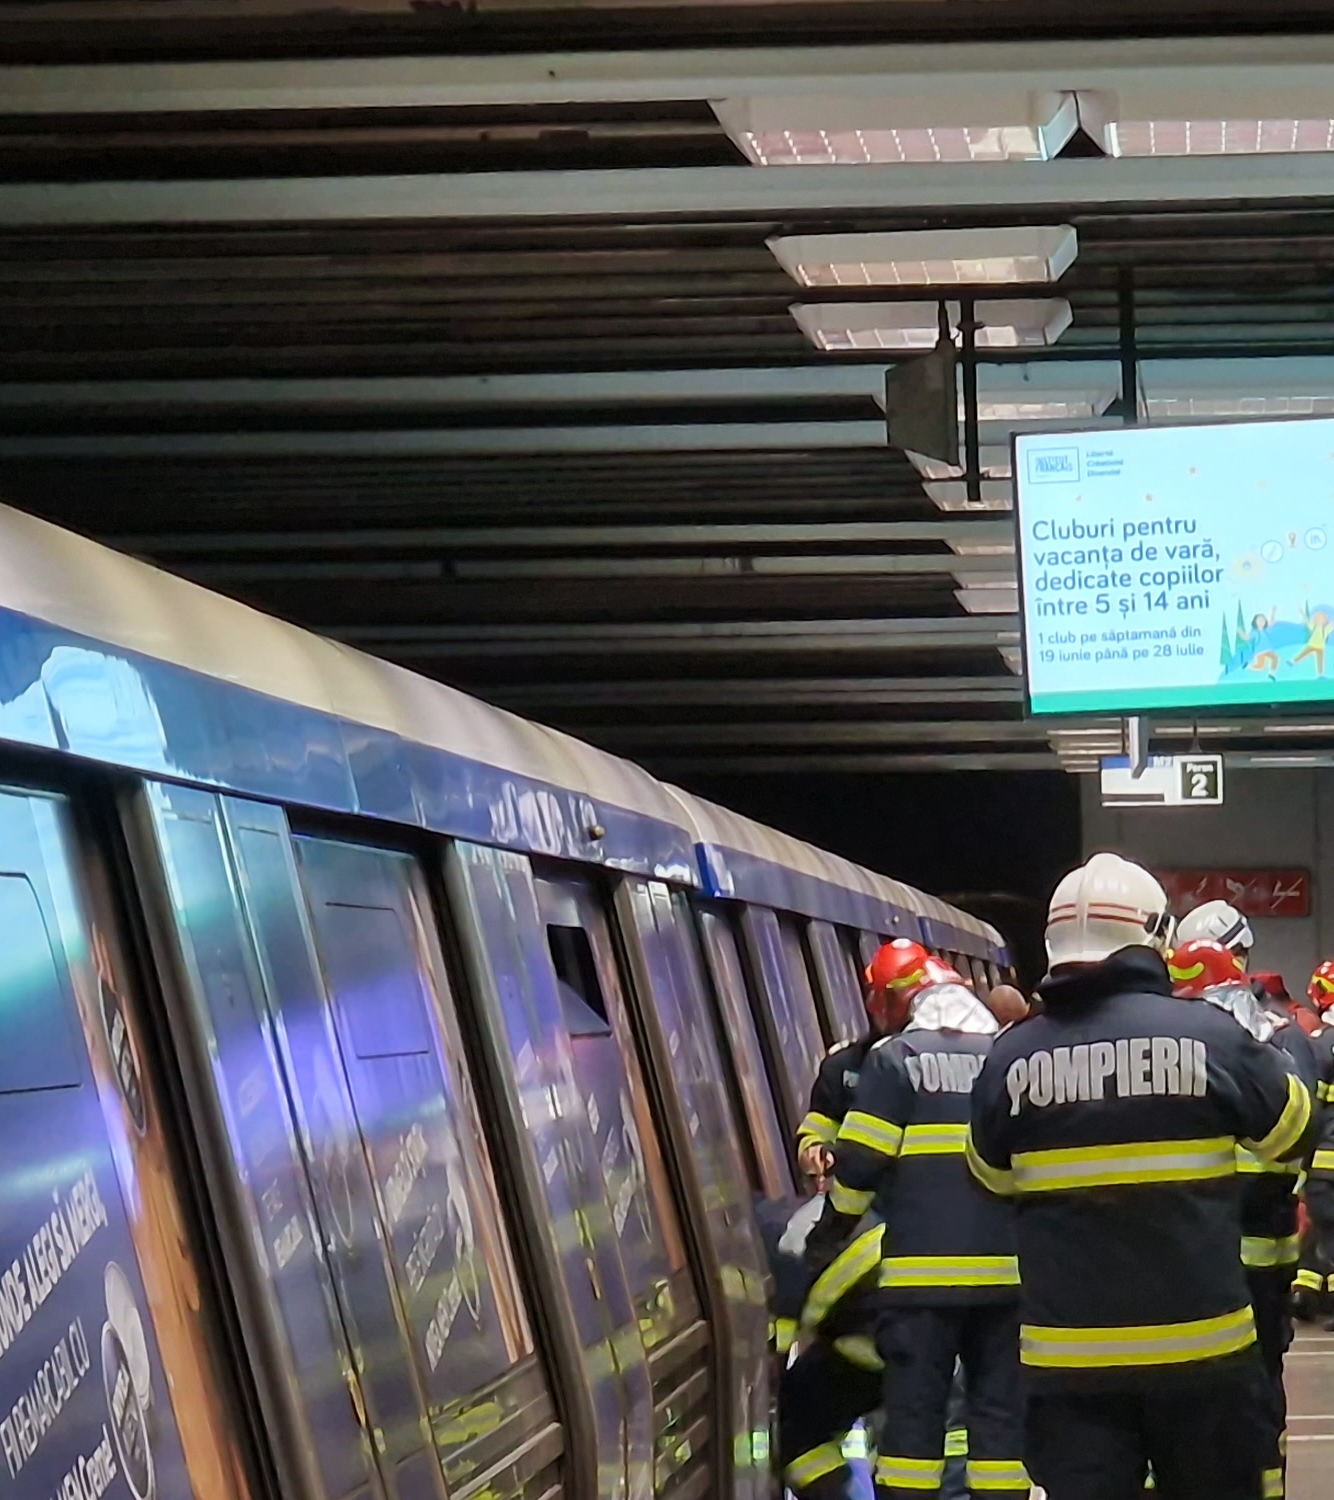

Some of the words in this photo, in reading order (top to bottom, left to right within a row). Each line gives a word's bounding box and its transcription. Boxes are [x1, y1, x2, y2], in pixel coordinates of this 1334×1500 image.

[1032, 517, 1115, 541] Cluburi
[1122, 516, 1197, 543] pentru
[1033, 545, 1123, 571] vacanța
[1130, 539, 1158, 562] de
[1164, 537, 1220, 563] vară,
[1034, 568, 1132, 592] dedicate
[1139, 562, 1224, 591] copiilor
[1034, 597, 1088, 617] între
[1095, 592, 1110, 614] 5
[1118, 592, 1136, 620] și
[1143, 590, 1169, 612] 14
[1176, 589, 1210, 611] ani
[1048, 630, 1077, 645] club
[1080, 632, 1097, 646] pe
[1180, 625, 1202, 639] din
[1039, 649, 1055, 663] 19
[1132, 648, 1149, 662] pe
[1153, 643, 1173, 658] 28
[1191, 773, 1209, 797] 2
[1006, 1036, 1208, 1118] POMPIERII
[68, 1315, 91, 1378] CU
